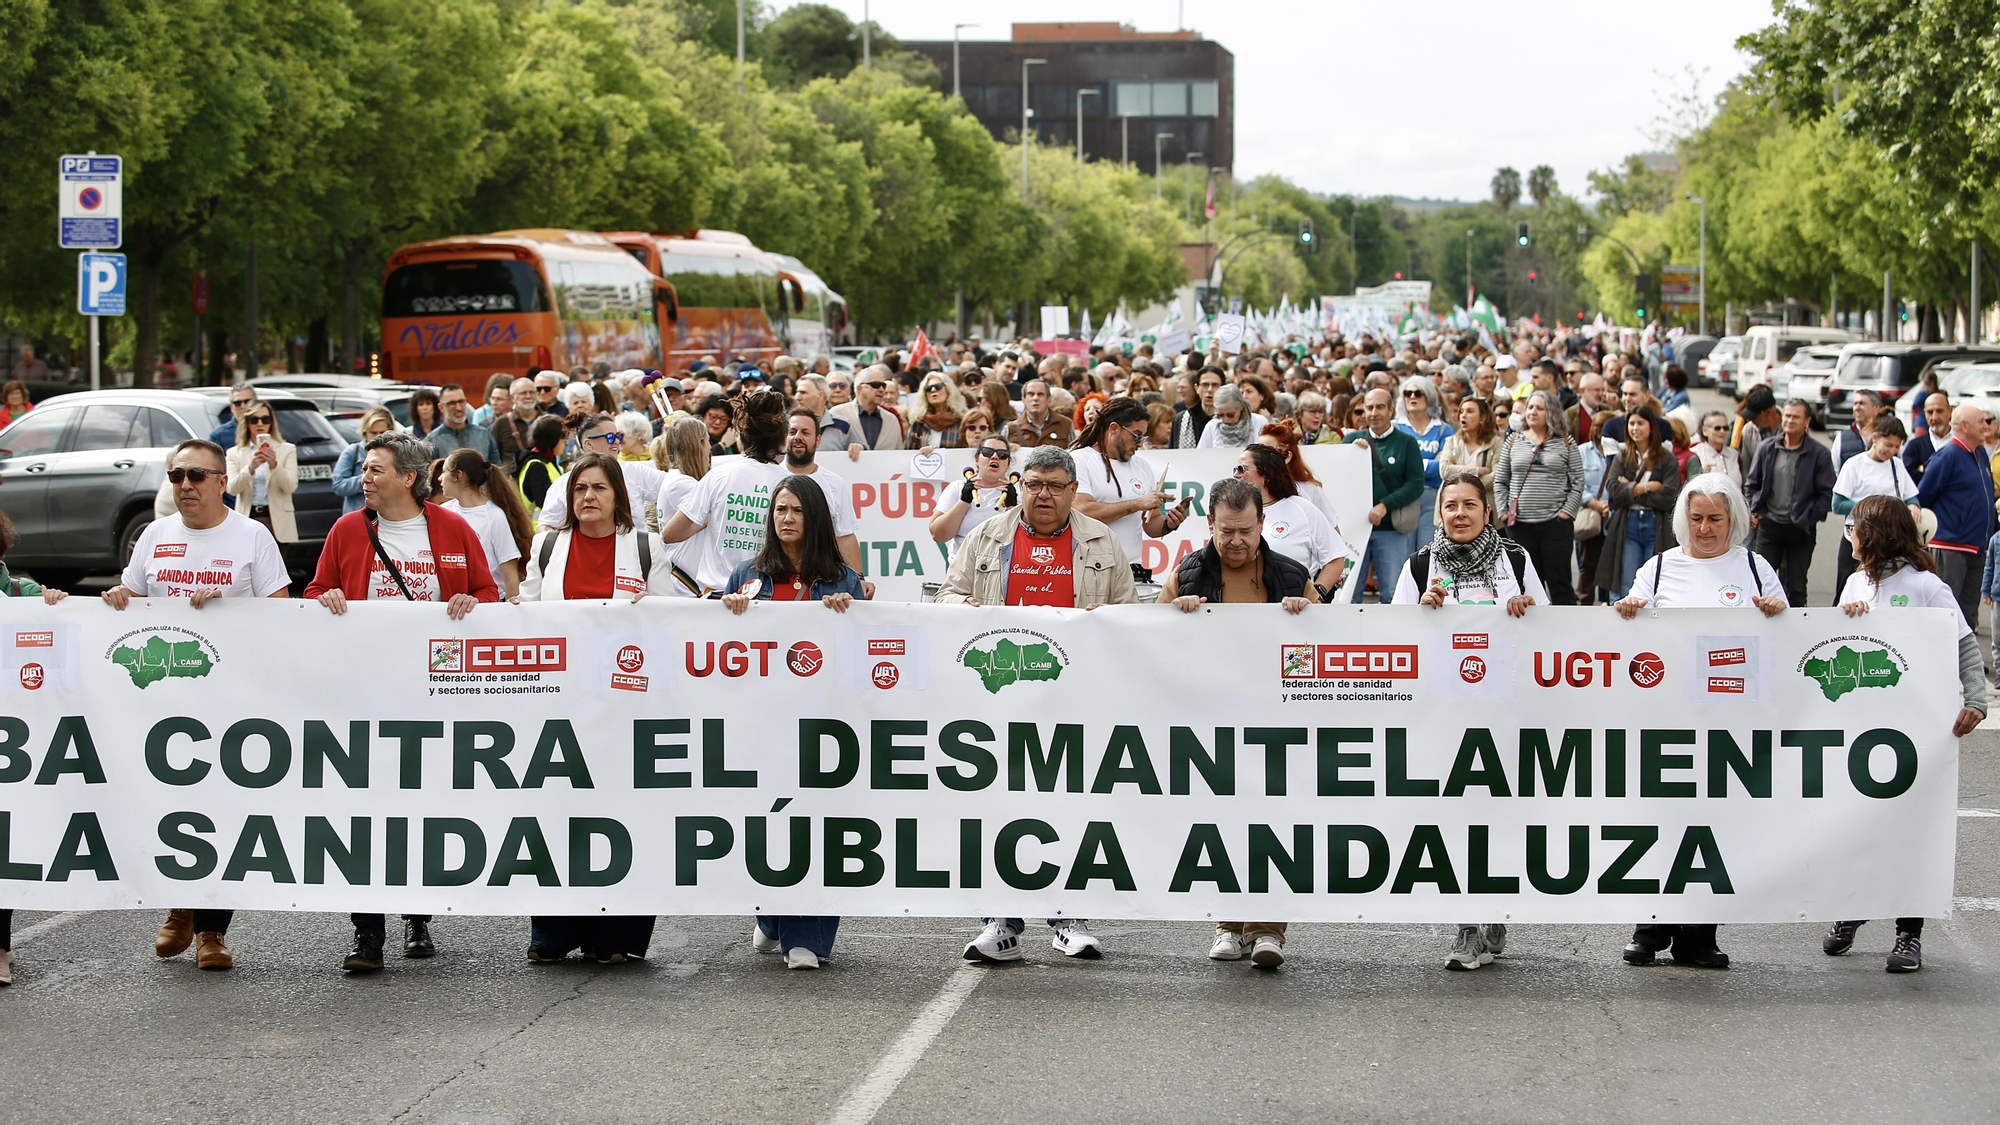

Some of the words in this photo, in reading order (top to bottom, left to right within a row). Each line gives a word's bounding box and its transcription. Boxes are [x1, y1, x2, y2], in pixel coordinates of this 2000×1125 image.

[64, 158, 76, 172] P
[89, 262, 118, 308] P
[754, 484, 769, 494] LA
[726, 493, 771, 509] SANID
[727, 508, 767, 525] PÚBLI
[725, 526, 738, 535] NO
[739, 527, 750, 536] SE
[723, 539, 735, 549] SE
[1031, 546, 1053, 556] UGT
[405, 557, 438, 576] PÚBLIC
[1010, 563, 1041, 575] Sanidad
[1043, 565, 1072, 576] Pública
[156, 568, 195, 584] SANIDAD
[196, 567, 233, 585] PÚBLICA
[167, 586, 181, 597] DE
[1025, 585, 1038, 593] con
[411, 590, 433, 601] D@S
[104, 629, 141, 660] COORDINADORA
[181, 628, 204, 642] MAREAS
[204, 638, 221, 663] BLANCAS
[870, 641, 897, 649] CCOO
[956, 631, 990, 663] COORDINADORA
[990, 627, 1021, 635] ANDALUZA
[1030, 630, 1053, 644] MAREAS
[1052, 641, 1070, 666] BLANCAS
[472, 644, 560, 666] CCOO
[619, 649, 641, 661] UGT
[685, 640, 778, 678] UGT
[1710, 651, 1737, 660] CCOO
[1796, 640, 1830, 673] COORDINADORA
[1830, 635, 1860, 643] ANDALUZA
[1869, 637, 1892, 650] MAREAS
[1891, 647, 1909, 672] BLANCAS
[1324, 652, 1412, 672] CCOO
[1462, 659, 1483, 672] UGT
[22, 666, 42, 678] UGT
[874, 666, 896, 678] UGT
[1533, 651, 1621, 688] UGT
[429, 673, 482, 682] federación
[485, 673, 498, 682] de
[500, 672, 540, 682] sanidad
[613, 676, 640, 685] CCOO
[1710, 679, 1736, 687] CCOO
[1281, 679, 1335, 688] federación
[1337, 679, 1350, 688] de
[1352, 679, 1392, 688] sanidad
[429, 687, 435, 696] y
[438, 686, 481, 694] sectores
[483, 684, 561, 695] sociosanitarios
[1282, 693, 1288, 702] y
[1290, 692, 1333, 701] sectores
[1336, 692, 1413, 701] sociosanitarios
[144, 716, 595, 790] CONTRA
[633, 718, 758, 789] EL
[798, 718, 1918, 799] DESMANTELAMIENTO
[0, 811, 120, 882] LA
[154, 811, 633, 888] SANIDAD
[675, 798, 1138, 892] PÚBLICA
[1168, 822, 1736, 896] ANDALUZA
